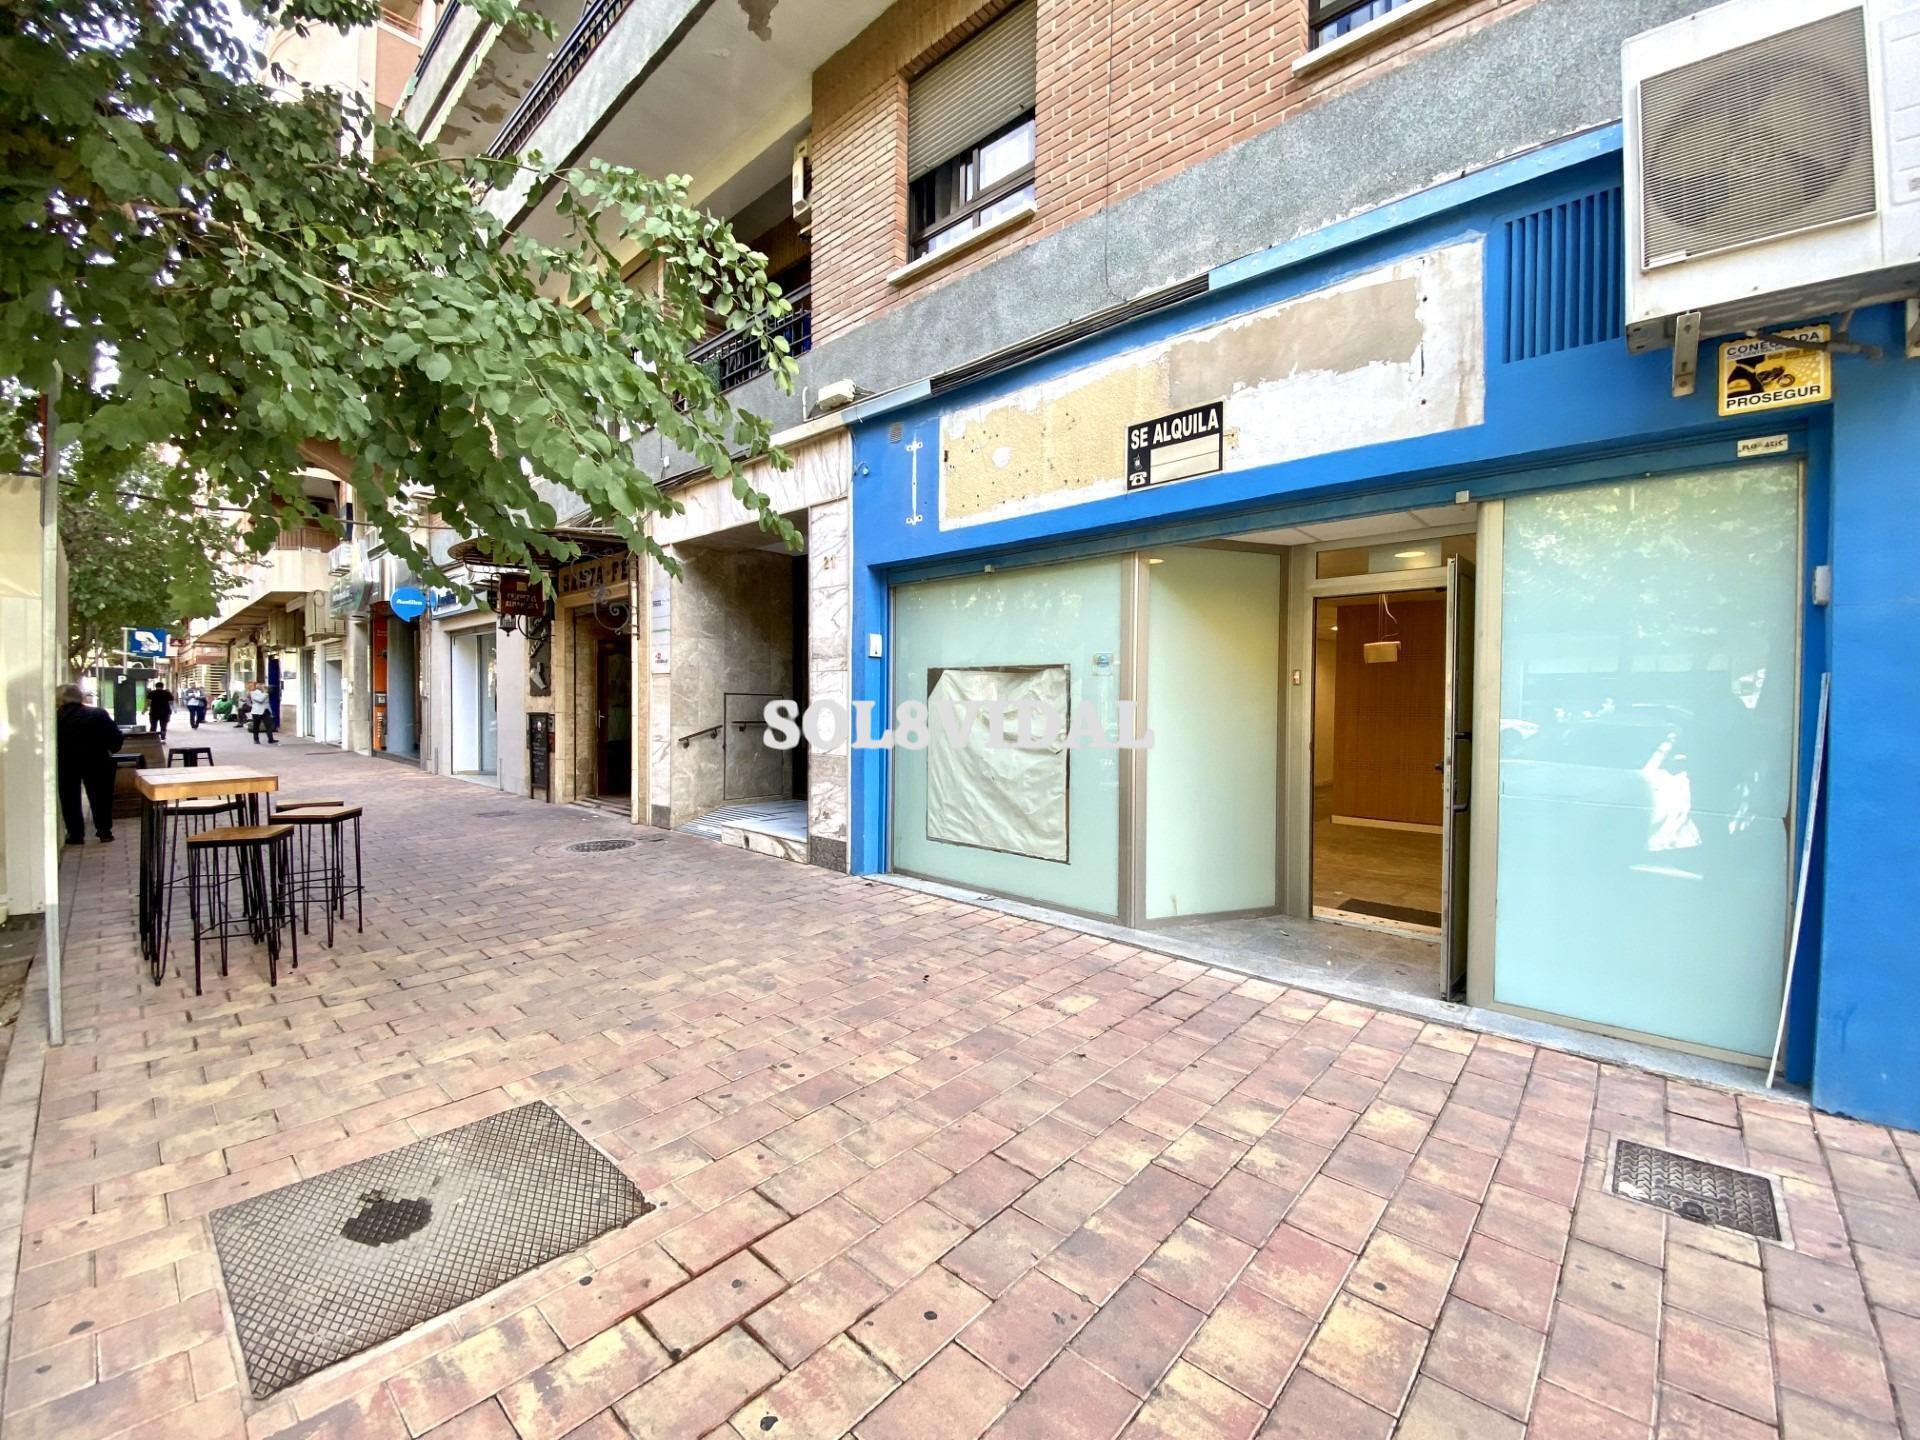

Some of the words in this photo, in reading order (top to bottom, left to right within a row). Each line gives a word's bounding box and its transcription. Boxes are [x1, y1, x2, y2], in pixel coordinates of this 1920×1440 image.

[1726, 384, 1821, 409] PROSEGUR
[1131, 427, 1149, 450] SE
[1153, 408, 1219, 444] ALQUILA
[118, 675, 127, 684] P
